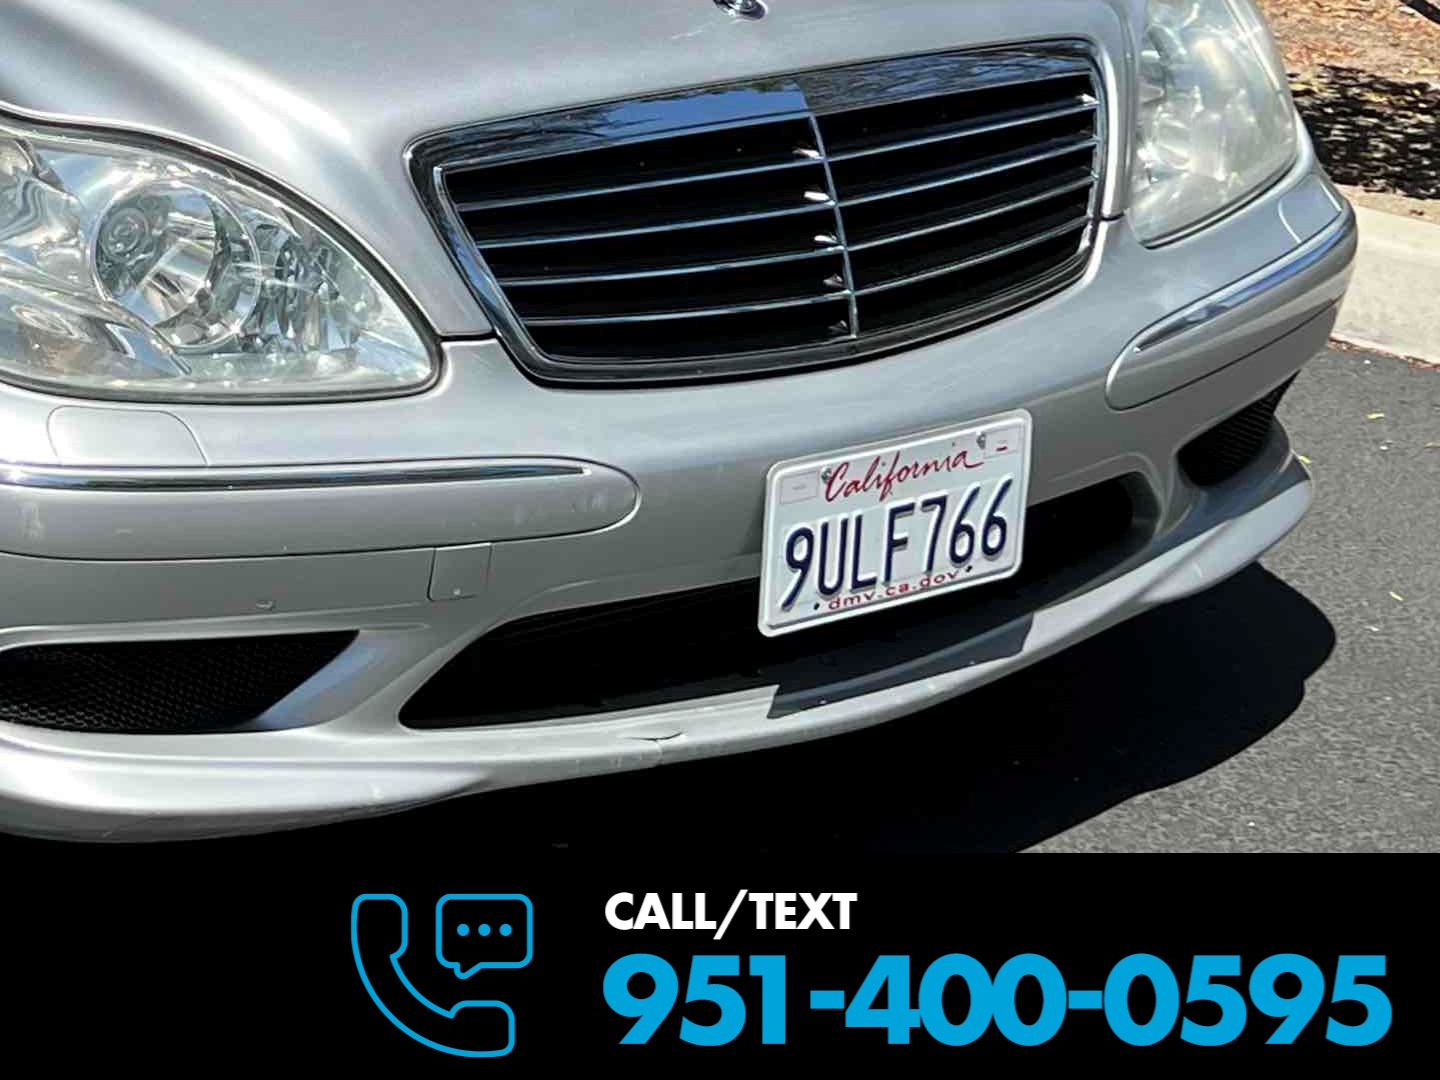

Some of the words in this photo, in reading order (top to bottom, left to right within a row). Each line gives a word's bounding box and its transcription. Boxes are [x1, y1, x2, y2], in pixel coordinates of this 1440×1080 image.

[823, 450, 983, 503] California
[780, 477, 1014, 612] 9ULF766
[828, 570, 960, 612] dmv.ca.gov
